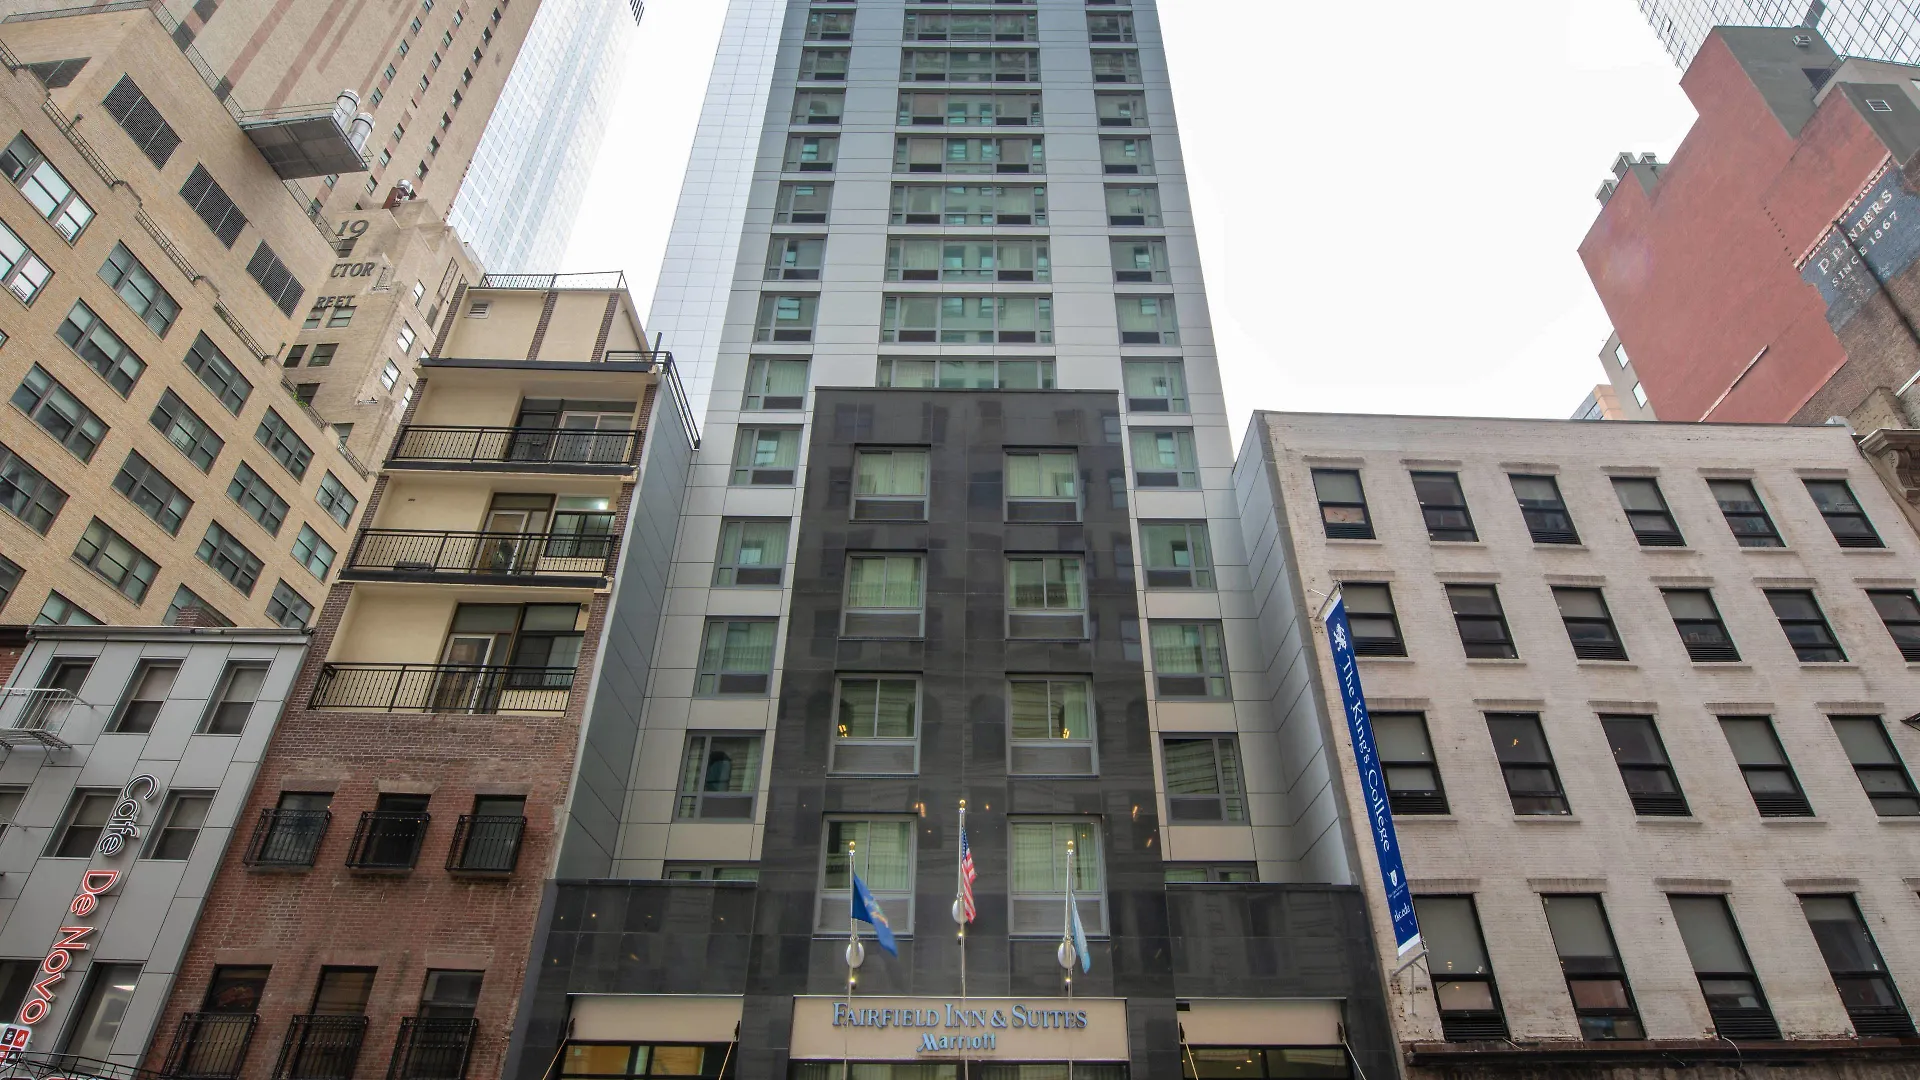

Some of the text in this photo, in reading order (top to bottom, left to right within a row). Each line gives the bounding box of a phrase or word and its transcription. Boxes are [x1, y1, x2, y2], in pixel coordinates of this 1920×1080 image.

[336, 219, 370, 238] 19
[1818, 189, 1893, 275] PRINTERS
[1832, 245, 1868, 287] SINCE
[1869, 210, 1898, 246] 1867
[330, 261, 376, 277] CTOR
[313, 294, 356, 308] REET
[1343, 654, 1390, 853] The King's College
[98, 773, 161, 857] Cafe
[70, 869, 122, 917] De
[832, 1002, 1089, 1029] FAIRFIELD INN & SUITES
[916, 1031, 997, 1053] Marriott
